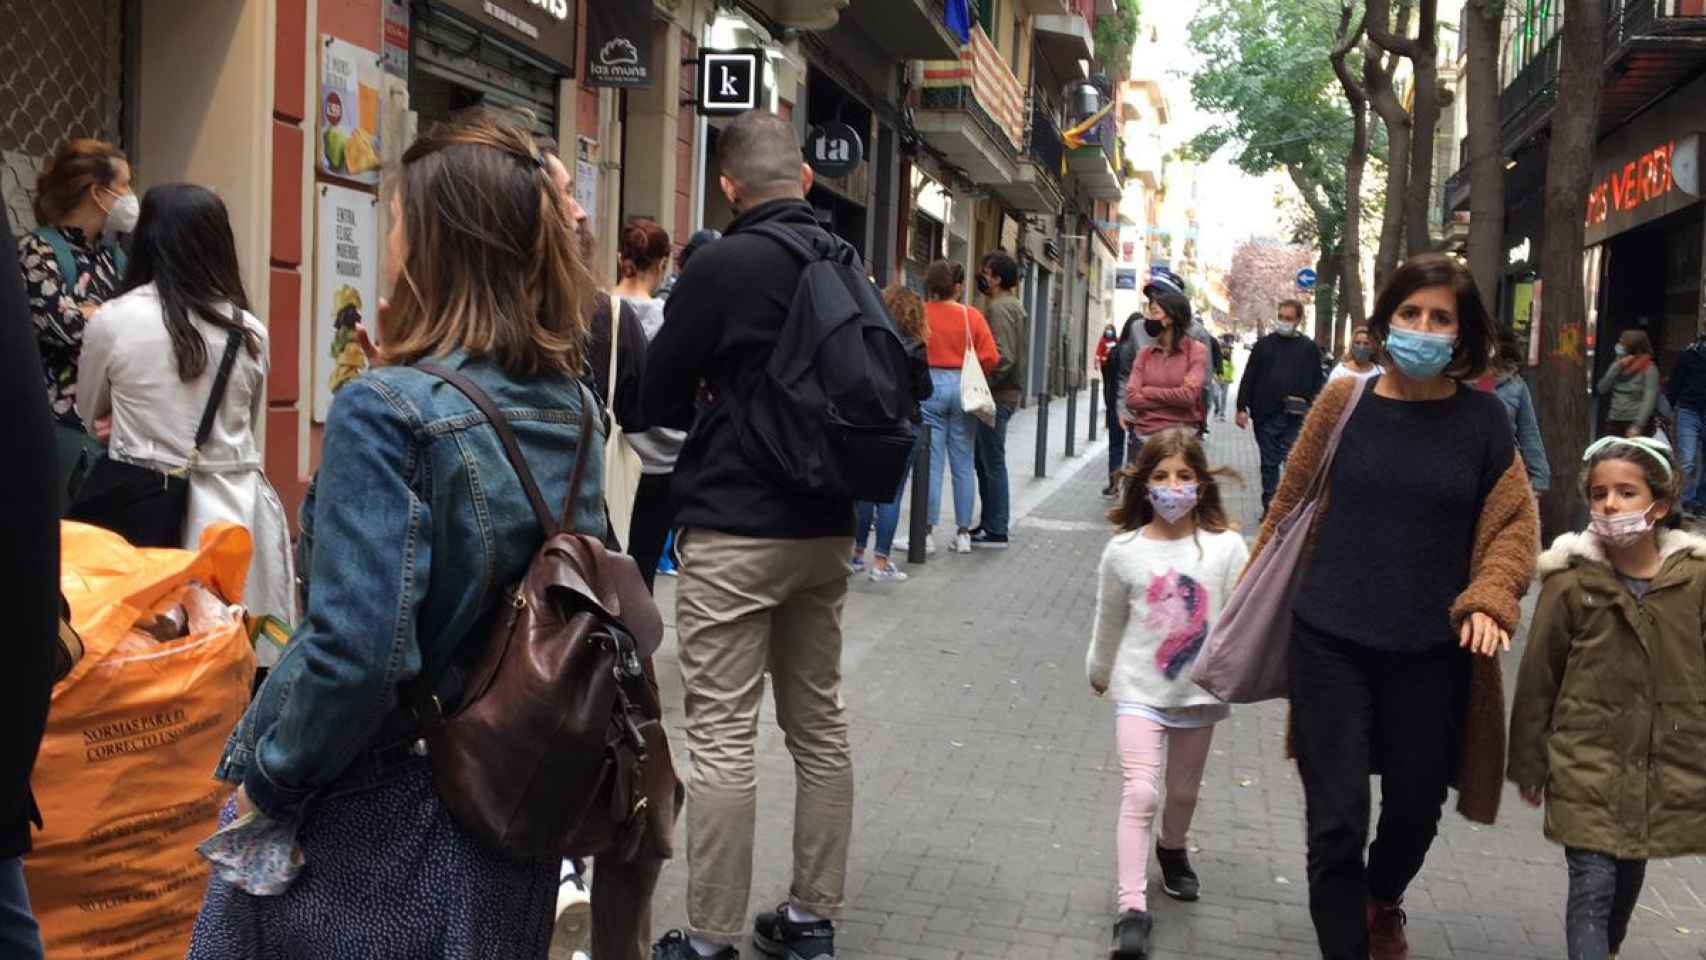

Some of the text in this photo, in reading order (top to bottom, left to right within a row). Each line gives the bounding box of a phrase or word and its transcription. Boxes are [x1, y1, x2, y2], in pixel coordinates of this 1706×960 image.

[591, 61, 647, 77] las muns
[719, 65, 739, 96] k
[815, 135, 850, 160] ta
[1610, 139, 1676, 211] VERDI
[83, 717, 138, 743] NORMAS
[139, 711, 174, 731] PARA
[86, 733, 159, 761] CORRECTO
